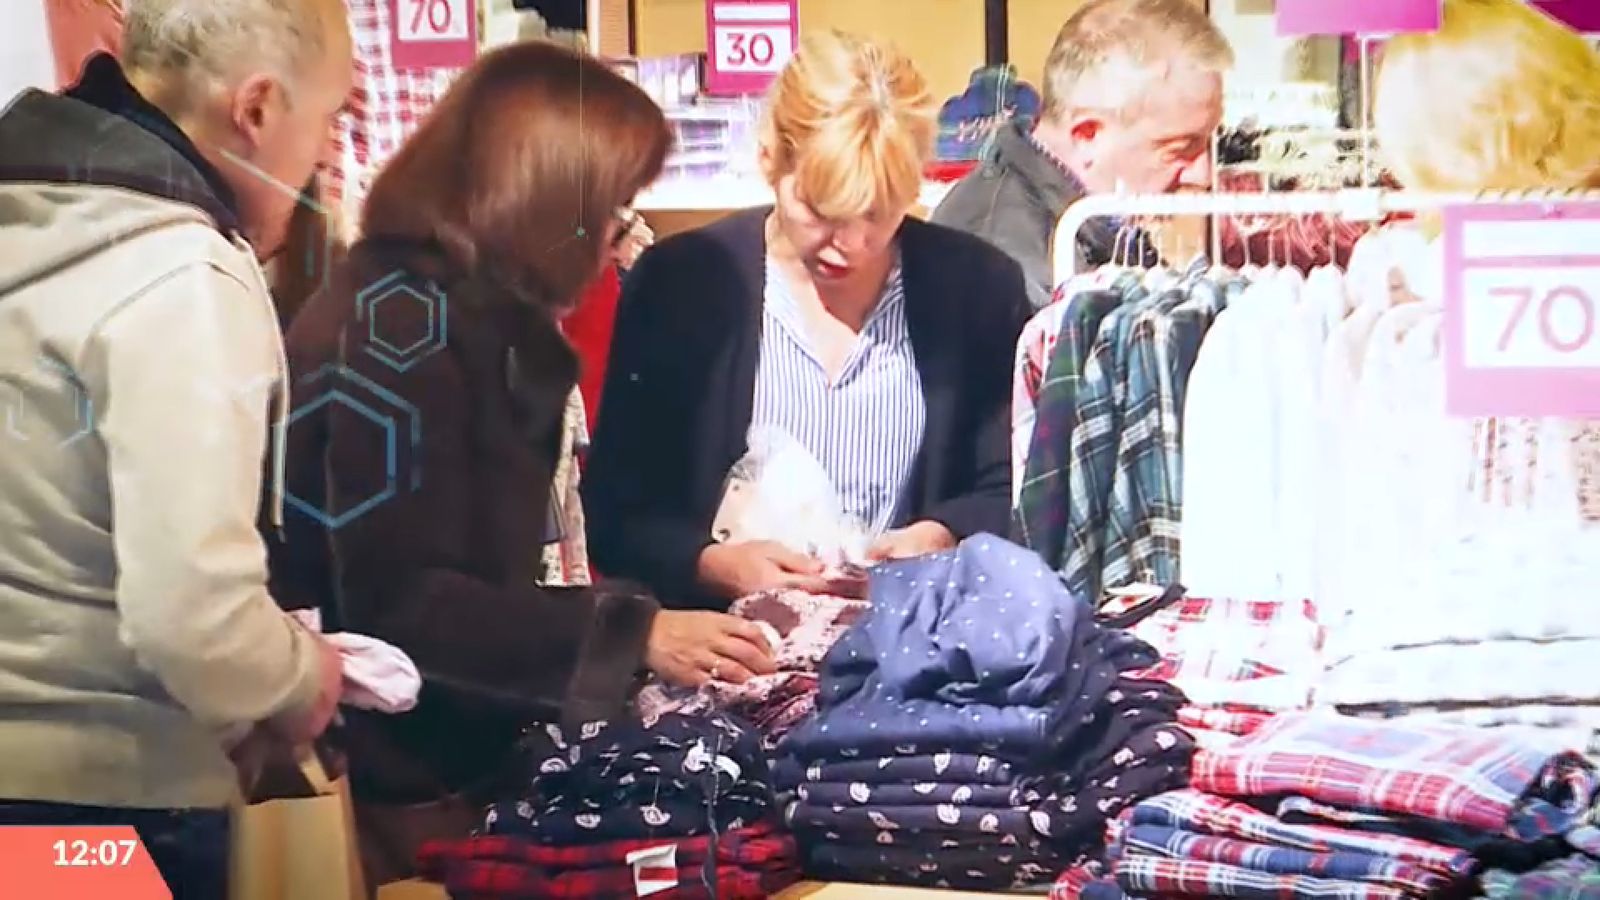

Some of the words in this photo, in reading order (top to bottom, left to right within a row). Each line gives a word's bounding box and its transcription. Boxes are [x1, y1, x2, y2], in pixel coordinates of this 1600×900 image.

[409, 0, 452, 33] 70
[726, 32, 774, 67] 30
[1487, 285, 1595, 353] 70
